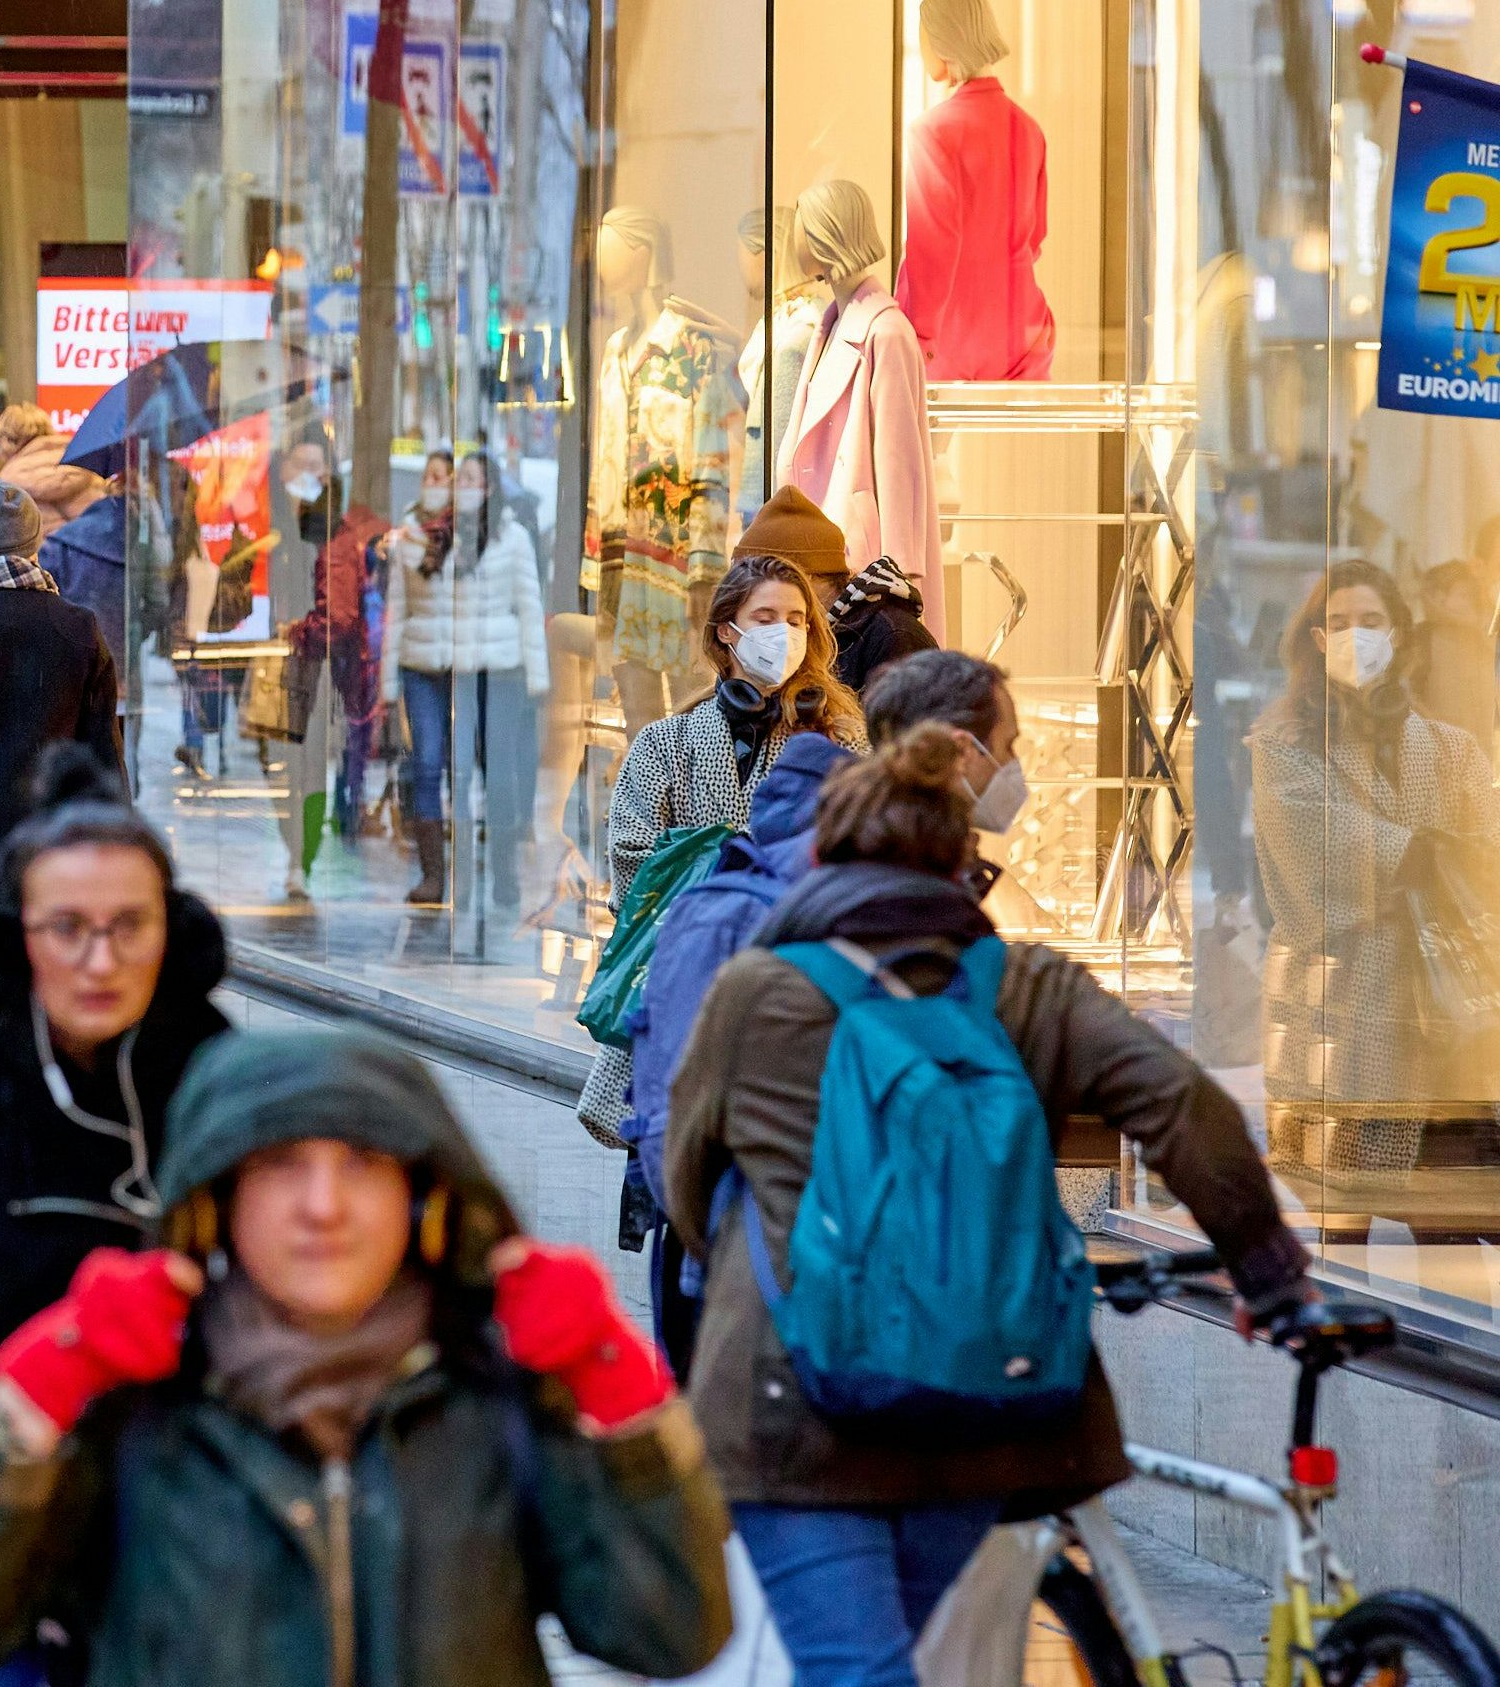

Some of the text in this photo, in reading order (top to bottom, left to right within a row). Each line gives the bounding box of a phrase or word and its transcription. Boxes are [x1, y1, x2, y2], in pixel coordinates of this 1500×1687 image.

[1467, 143, 1500, 168] ME
[1418, 171, 1500, 296] 2
[53, 304, 129, 332] Bitte
[55, 340, 172, 369] Verstä
[1397, 373, 1500, 404] EUROMI
